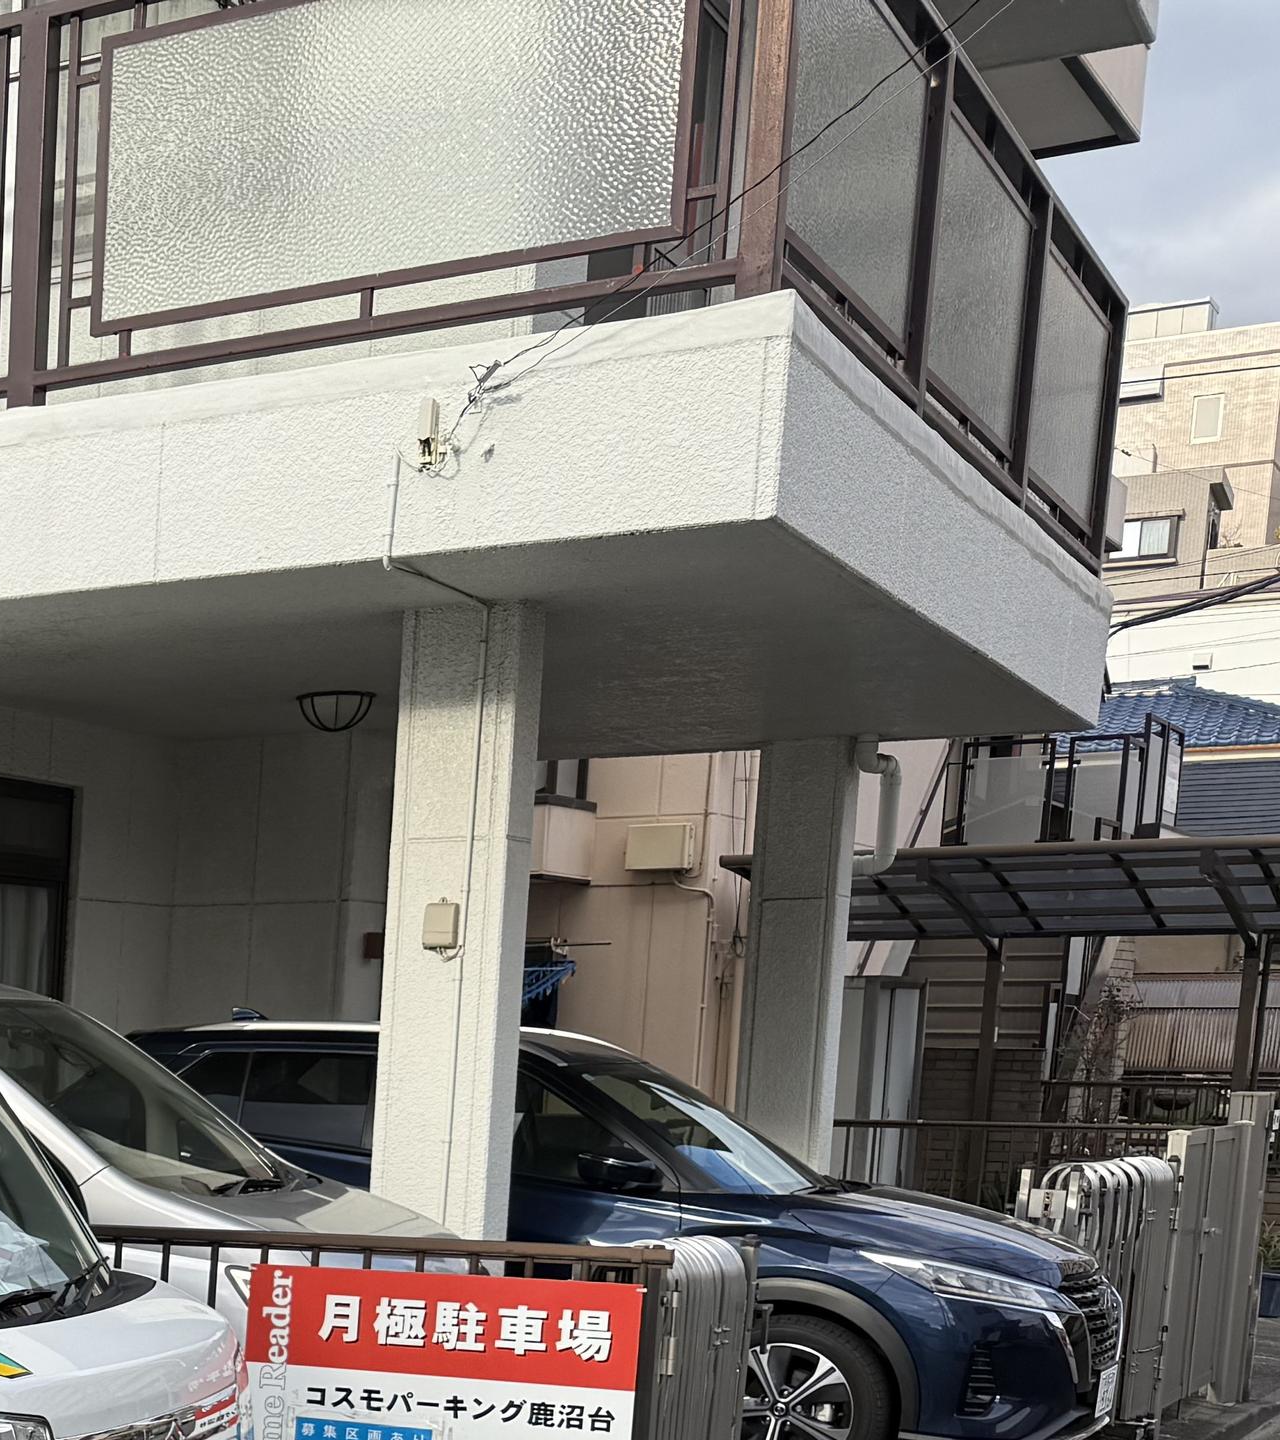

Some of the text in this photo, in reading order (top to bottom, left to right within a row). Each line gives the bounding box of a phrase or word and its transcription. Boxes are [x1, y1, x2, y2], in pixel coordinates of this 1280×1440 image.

[259, 1269, 293, 1391] Reader
[318, 1293, 613, 1362] 月極駐車場
[306, 1385, 616, 1434] コスモパーキング鹿沼台
